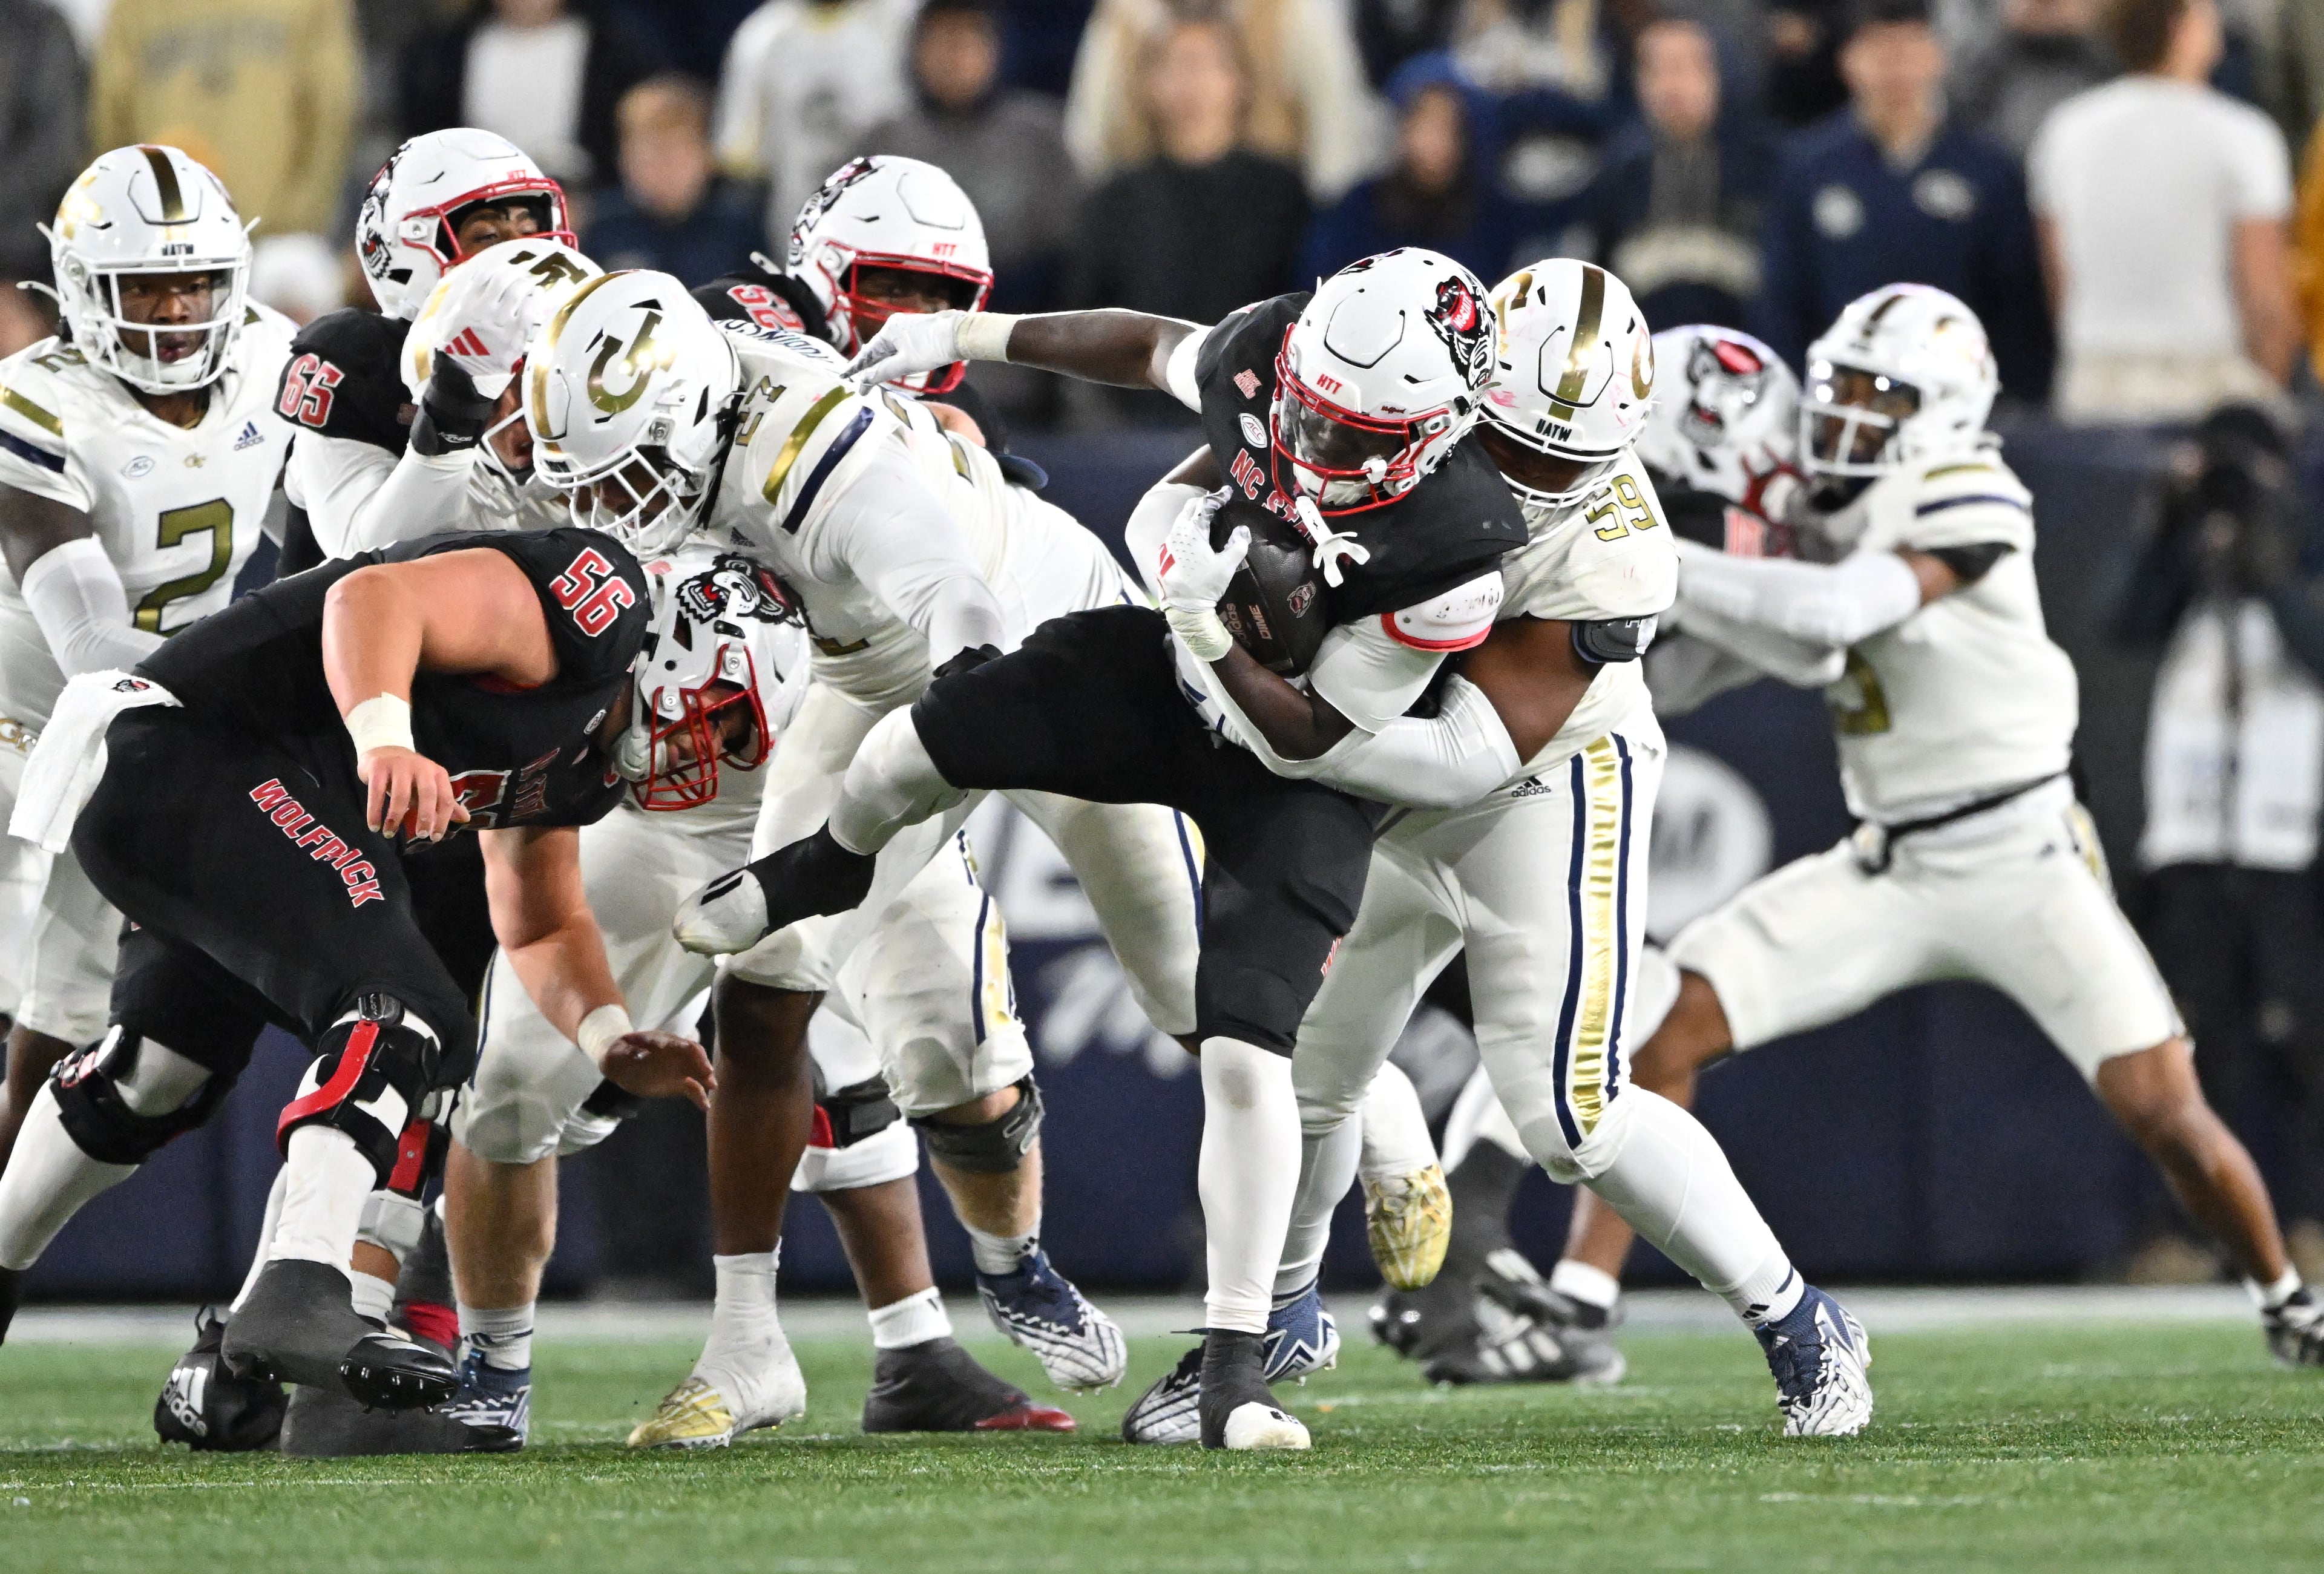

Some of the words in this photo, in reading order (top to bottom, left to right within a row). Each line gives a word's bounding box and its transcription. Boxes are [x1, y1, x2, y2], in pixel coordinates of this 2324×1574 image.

[932, 242, 957, 257] HTT
[279, 352, 345, 428] 65
[1316, 373, 1343, 395] HTT
[1535, 418, 1573, 442] UATW
[1230, 447, 1265, 500] NC
[1584, 474, 1659, 542] 59
[132, 497, 234, 638] 2
[548, 546, 636, 638] 56
[1248, 604, 1273, 640] DIME
[1511, 785, 1552, 798] adidas
[249, 778, 386, 908] WOLFPACK
[162, 1380, 208, 1437] didas
